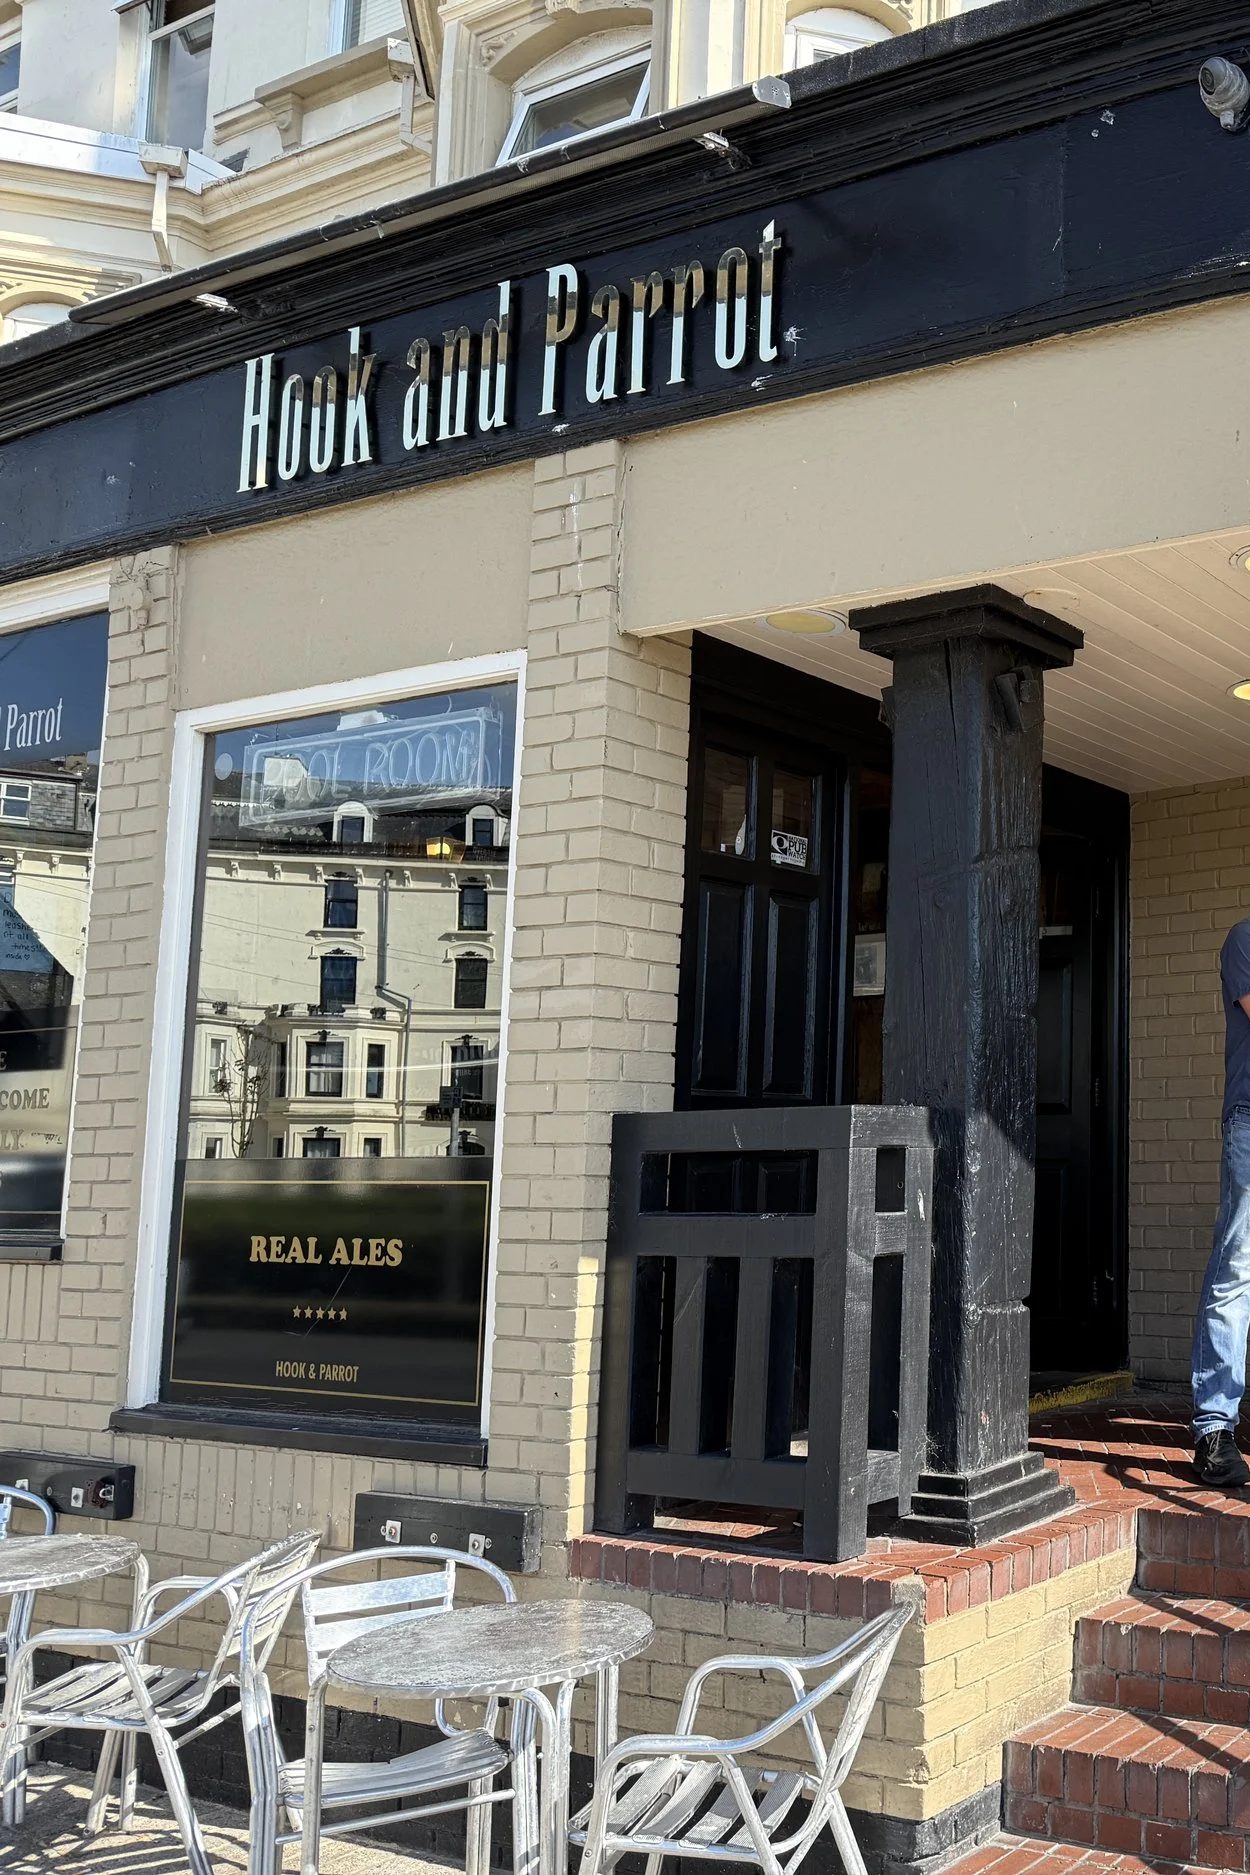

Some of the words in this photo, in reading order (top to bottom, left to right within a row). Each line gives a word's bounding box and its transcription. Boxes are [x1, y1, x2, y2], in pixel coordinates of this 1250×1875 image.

[237, 326, 380, 494] Hook
[402, 281, 510, 451] and
[537, 218, 782, 416] Parrot
[4, 697, 63, 751] Parrot
[260, 744, 351, 809] POOL
[363, 731, 474, 796] ROOM
[788, 840, 807, 854] PUB
[250, 1235, 323, 1265] REAL
[328, 1236, 403, 1267] ALES
[275, 1360, 307, 1379] HOOK
[308, 1363, 316, 1380] &
[319, 1363, 359, 1383] PARROT
